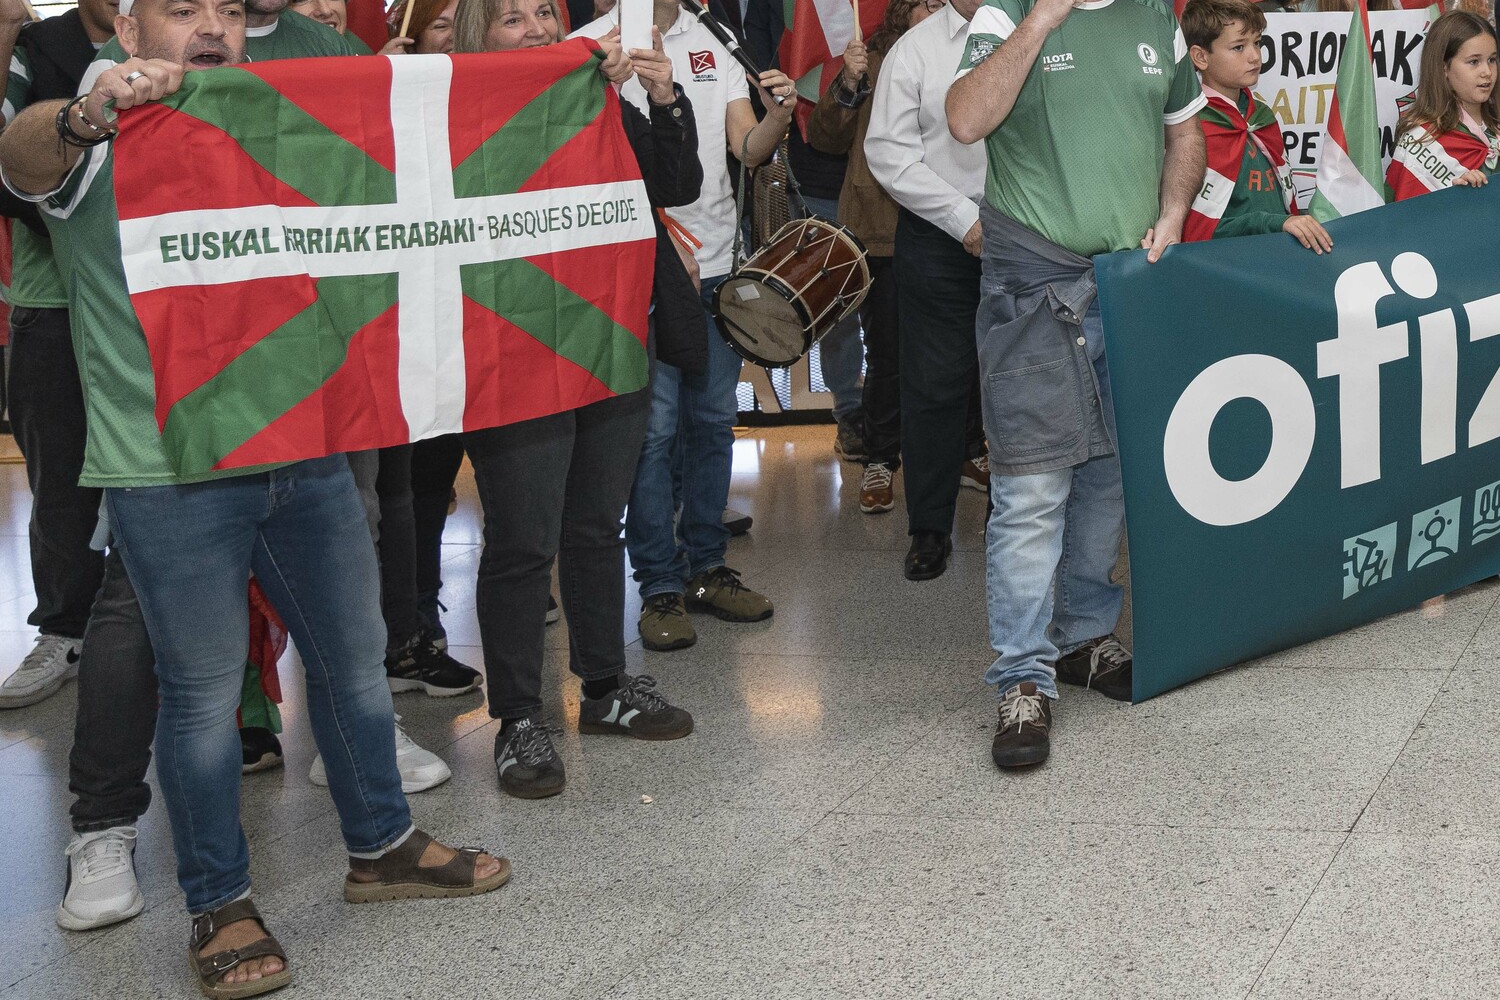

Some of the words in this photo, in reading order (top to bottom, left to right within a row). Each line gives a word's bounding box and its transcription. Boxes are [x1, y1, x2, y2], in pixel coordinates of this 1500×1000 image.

[159, 226, 280, 264] EUSKAL
[375, 217, 476, 251] ERABAKI
[486, 206, 573, 240] BASQUES
[576, 198, 638, 228] DECIDE
